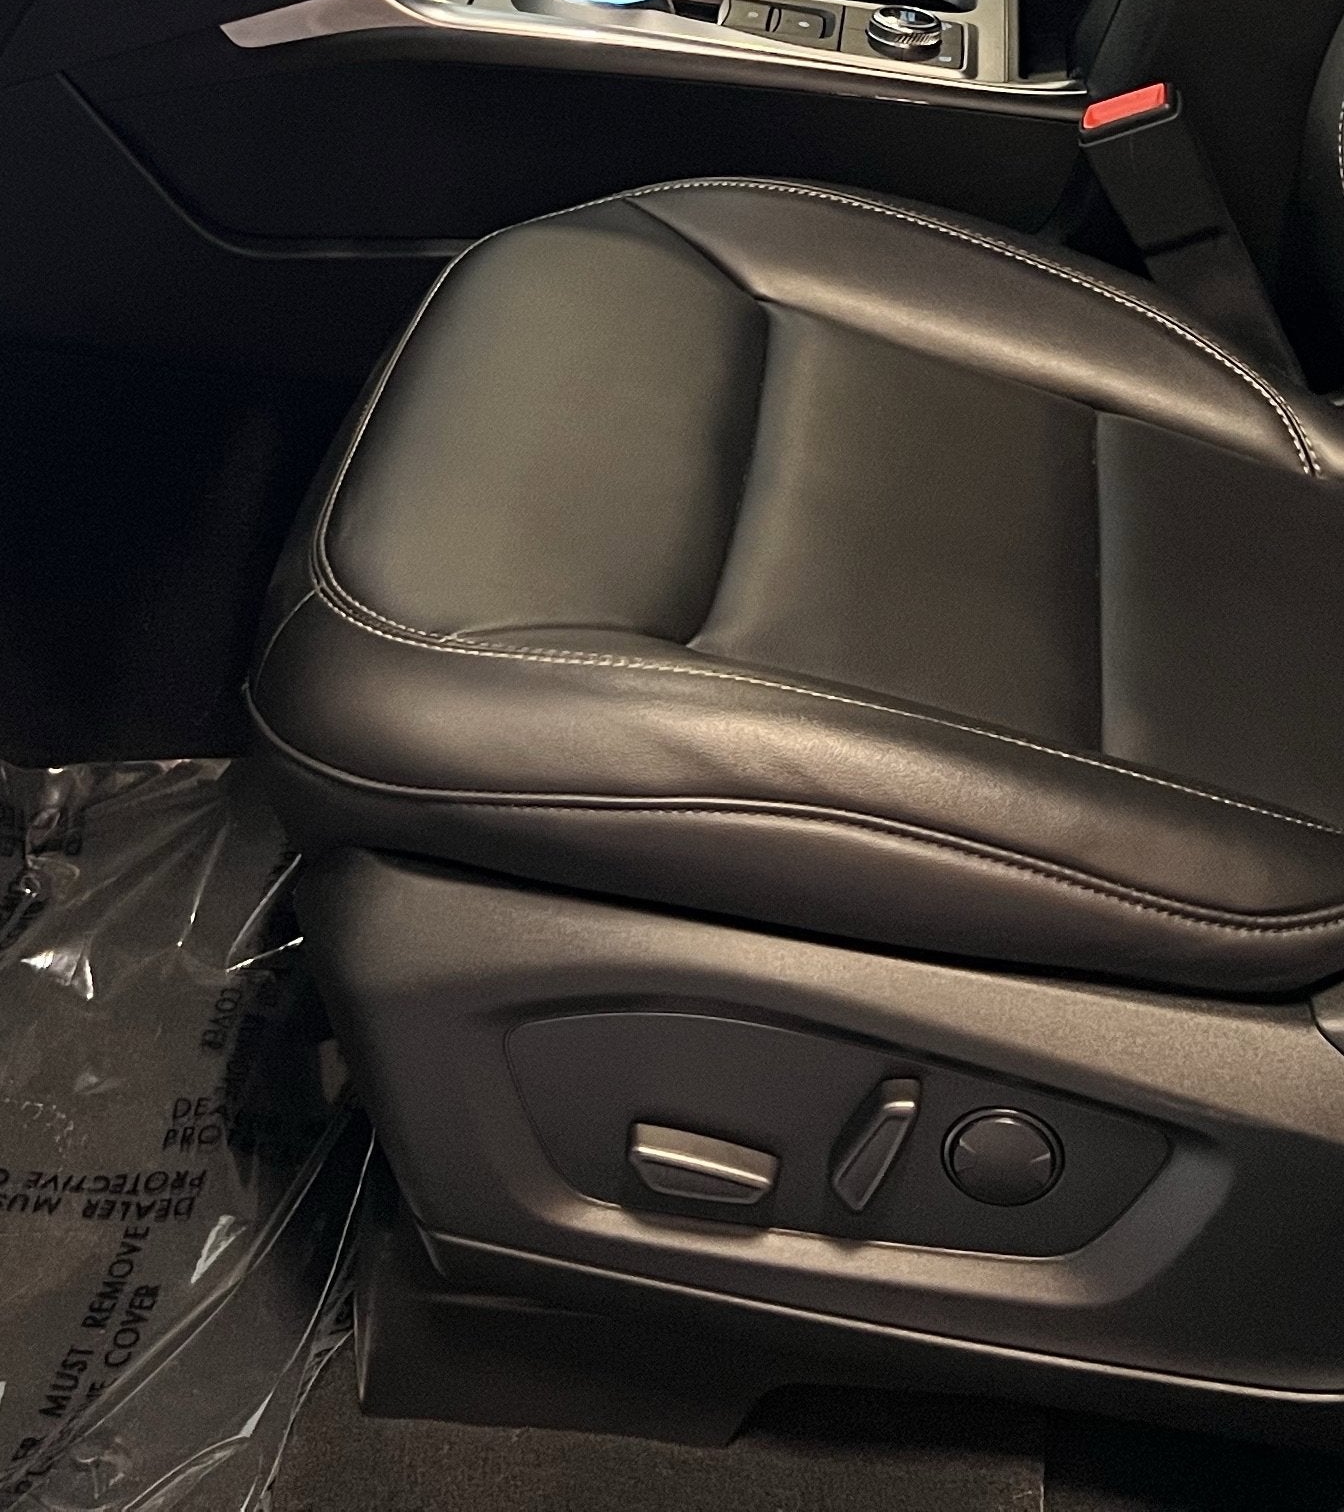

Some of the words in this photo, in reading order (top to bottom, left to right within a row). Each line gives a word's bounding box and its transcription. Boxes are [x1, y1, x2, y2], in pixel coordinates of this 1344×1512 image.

[22, 1168, 208, 1195] PROTECTIVE
[81, 1195, 196, 1222] DEALER
[39, 1346, 94, 1419] MUST
[81, 1224, 151, 1331] REMOVE
[103, 1283, 160, 1370] COVER
